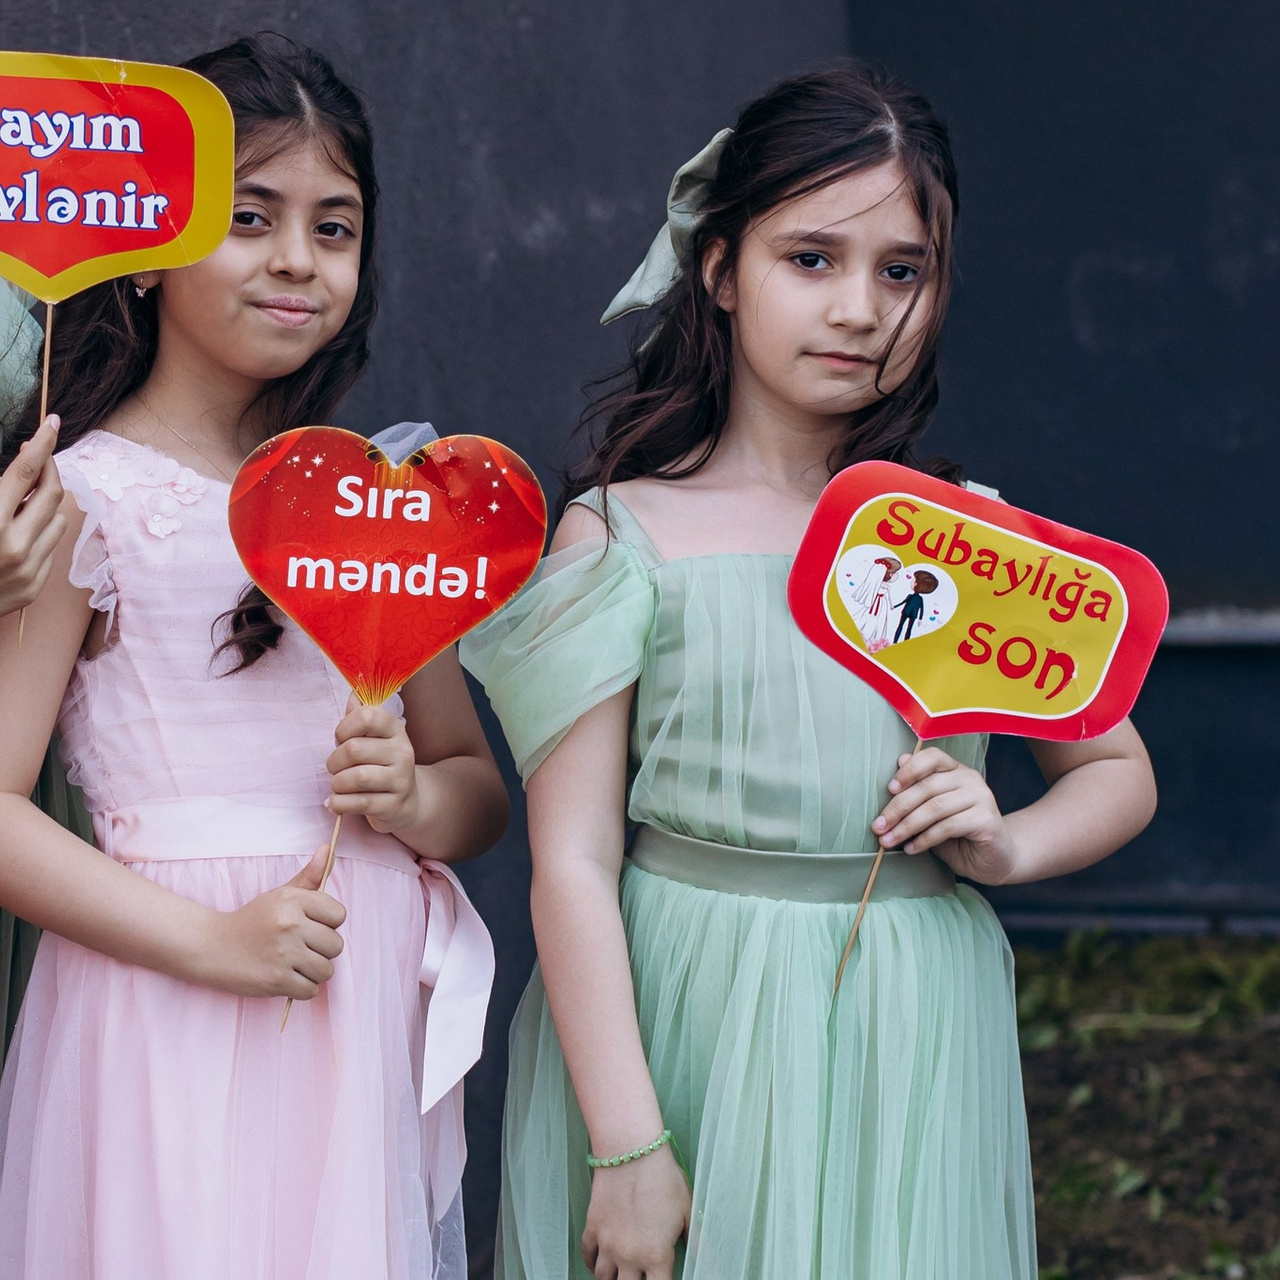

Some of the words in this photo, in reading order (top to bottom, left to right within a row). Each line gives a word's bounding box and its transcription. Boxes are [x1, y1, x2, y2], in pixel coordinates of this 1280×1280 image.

[334, 475, 431, 522] Sıra
[286, 553, 488, 600] məndə!
[875, 500, 1112, 623] Subaylığa
